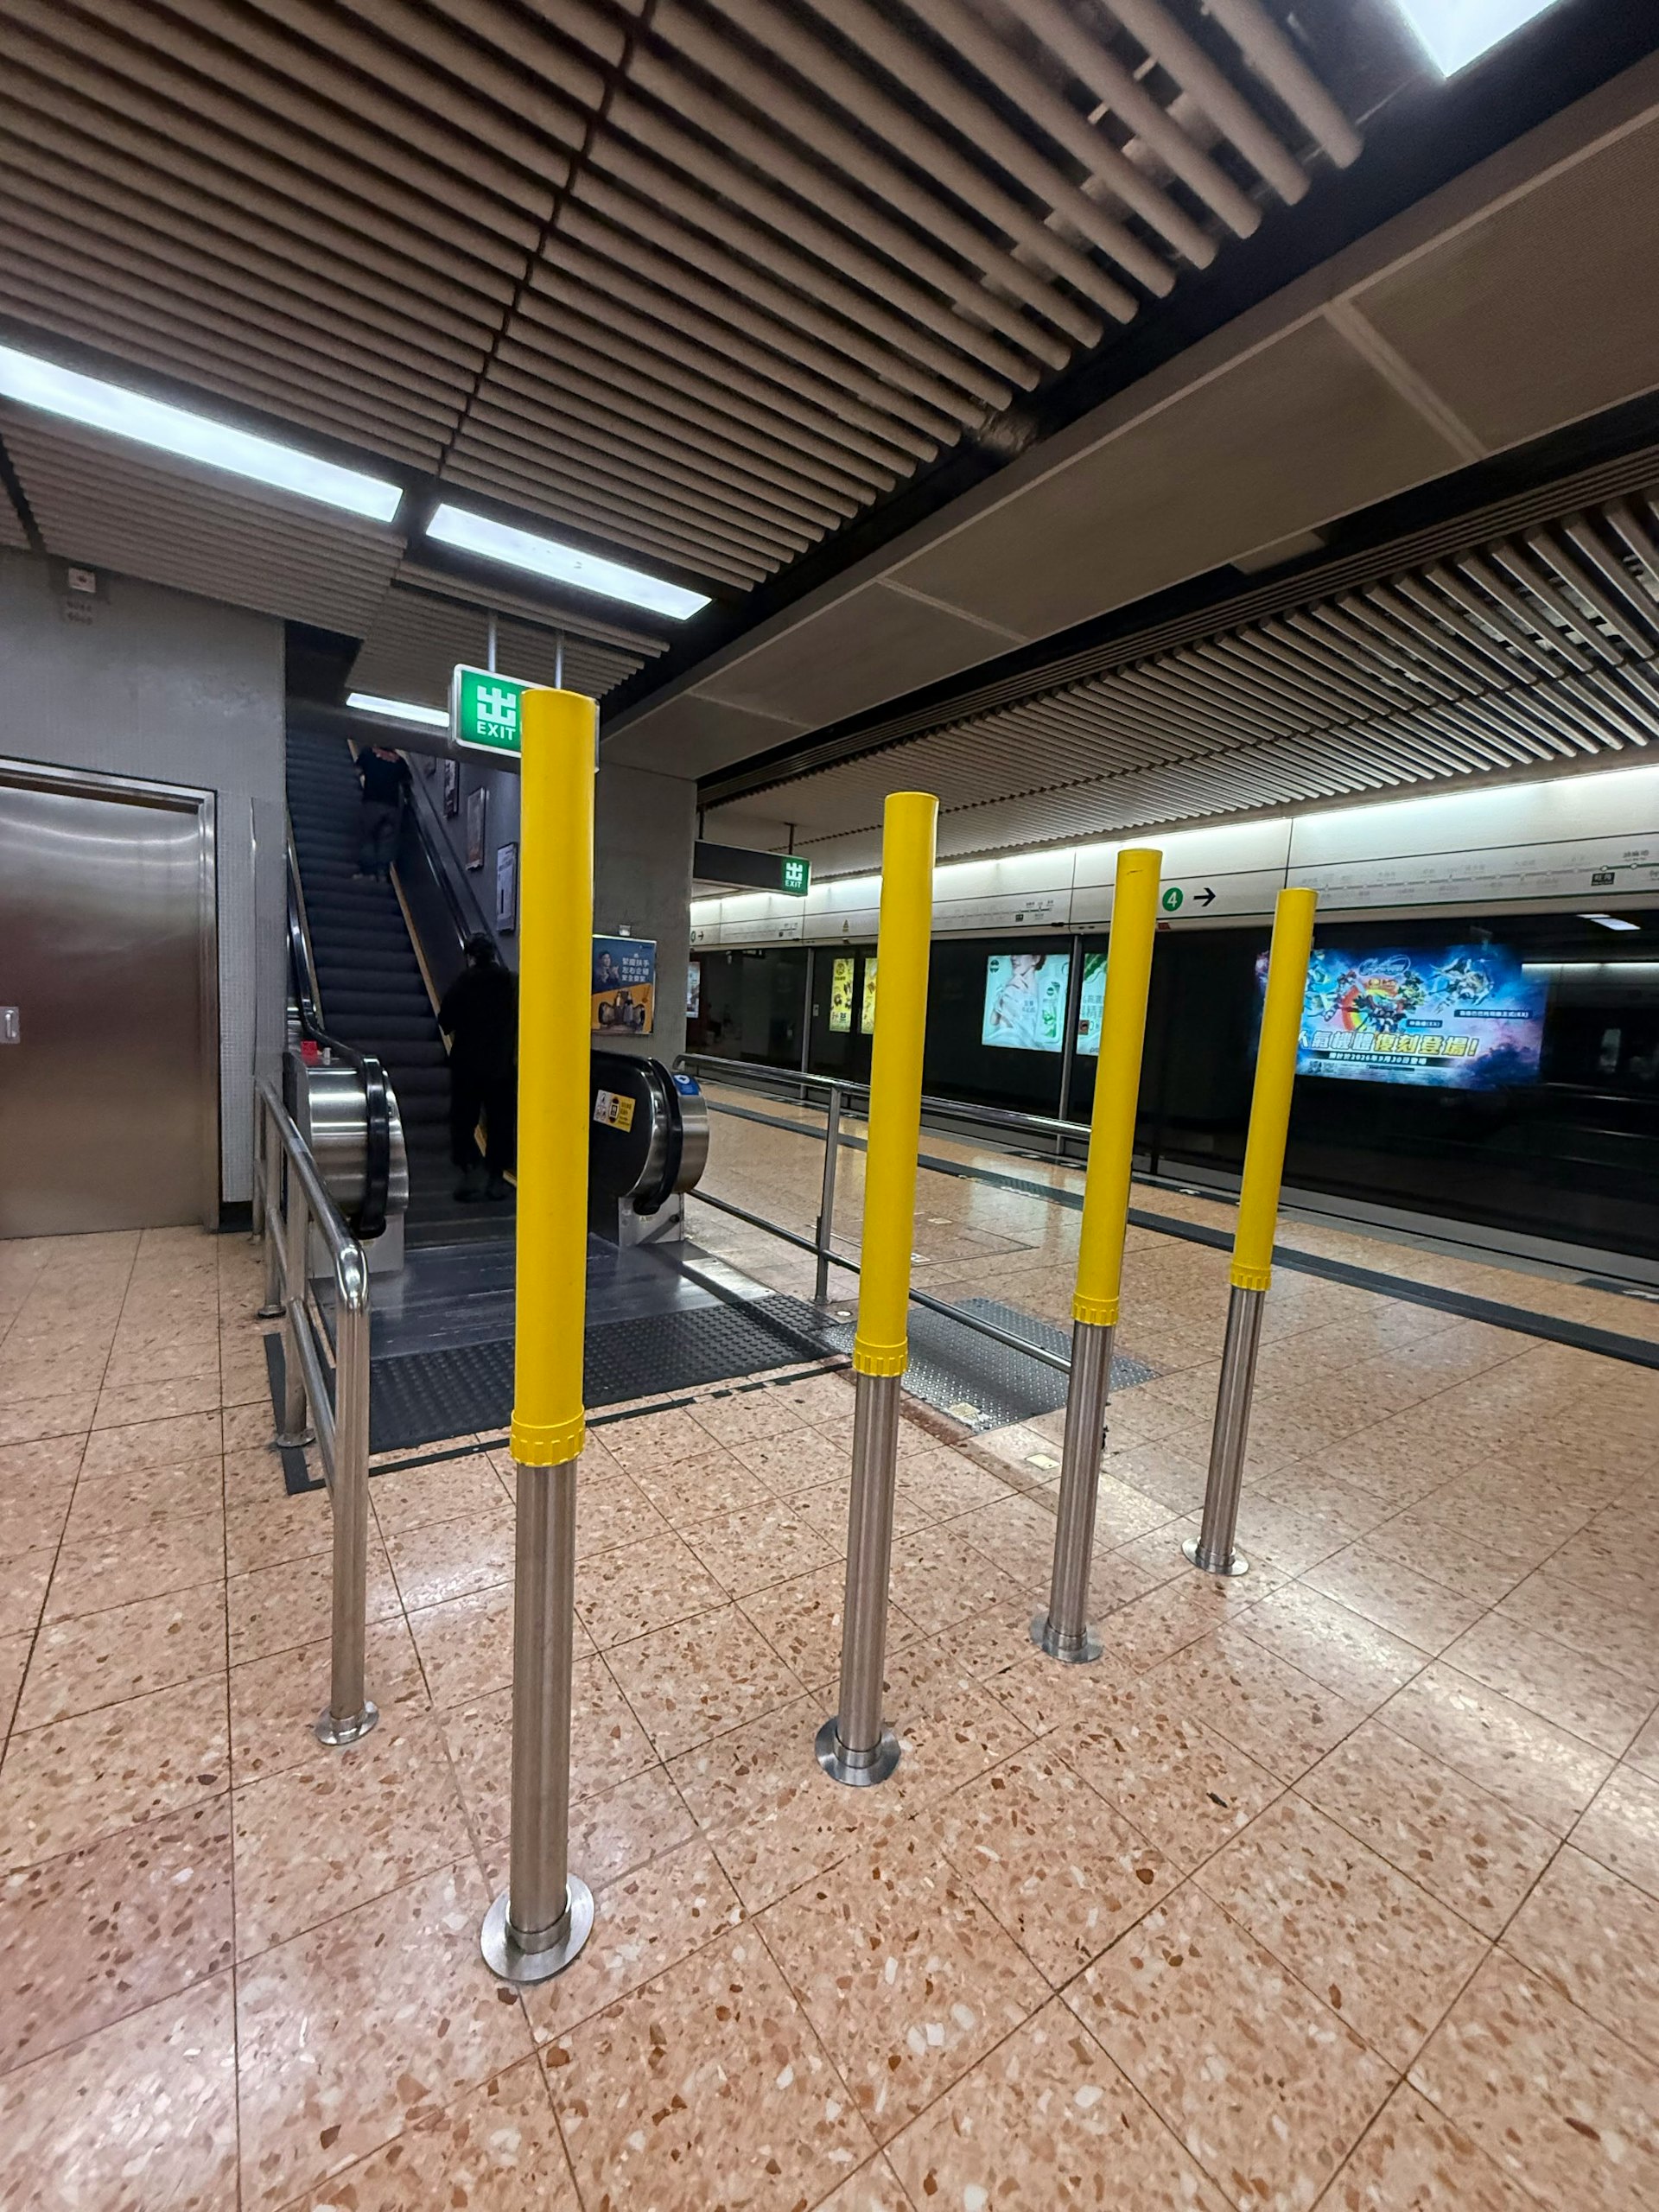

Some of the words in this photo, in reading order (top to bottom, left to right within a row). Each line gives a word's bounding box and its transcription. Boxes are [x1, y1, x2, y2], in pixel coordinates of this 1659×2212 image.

[476, 684, 517, 728] 出
[476, 720, 517, 741] EXIT
[785, 861, 804, 881] 出
[785, 880, 803, 889] EXIT
[1166, 891, 1179, 908] 4
